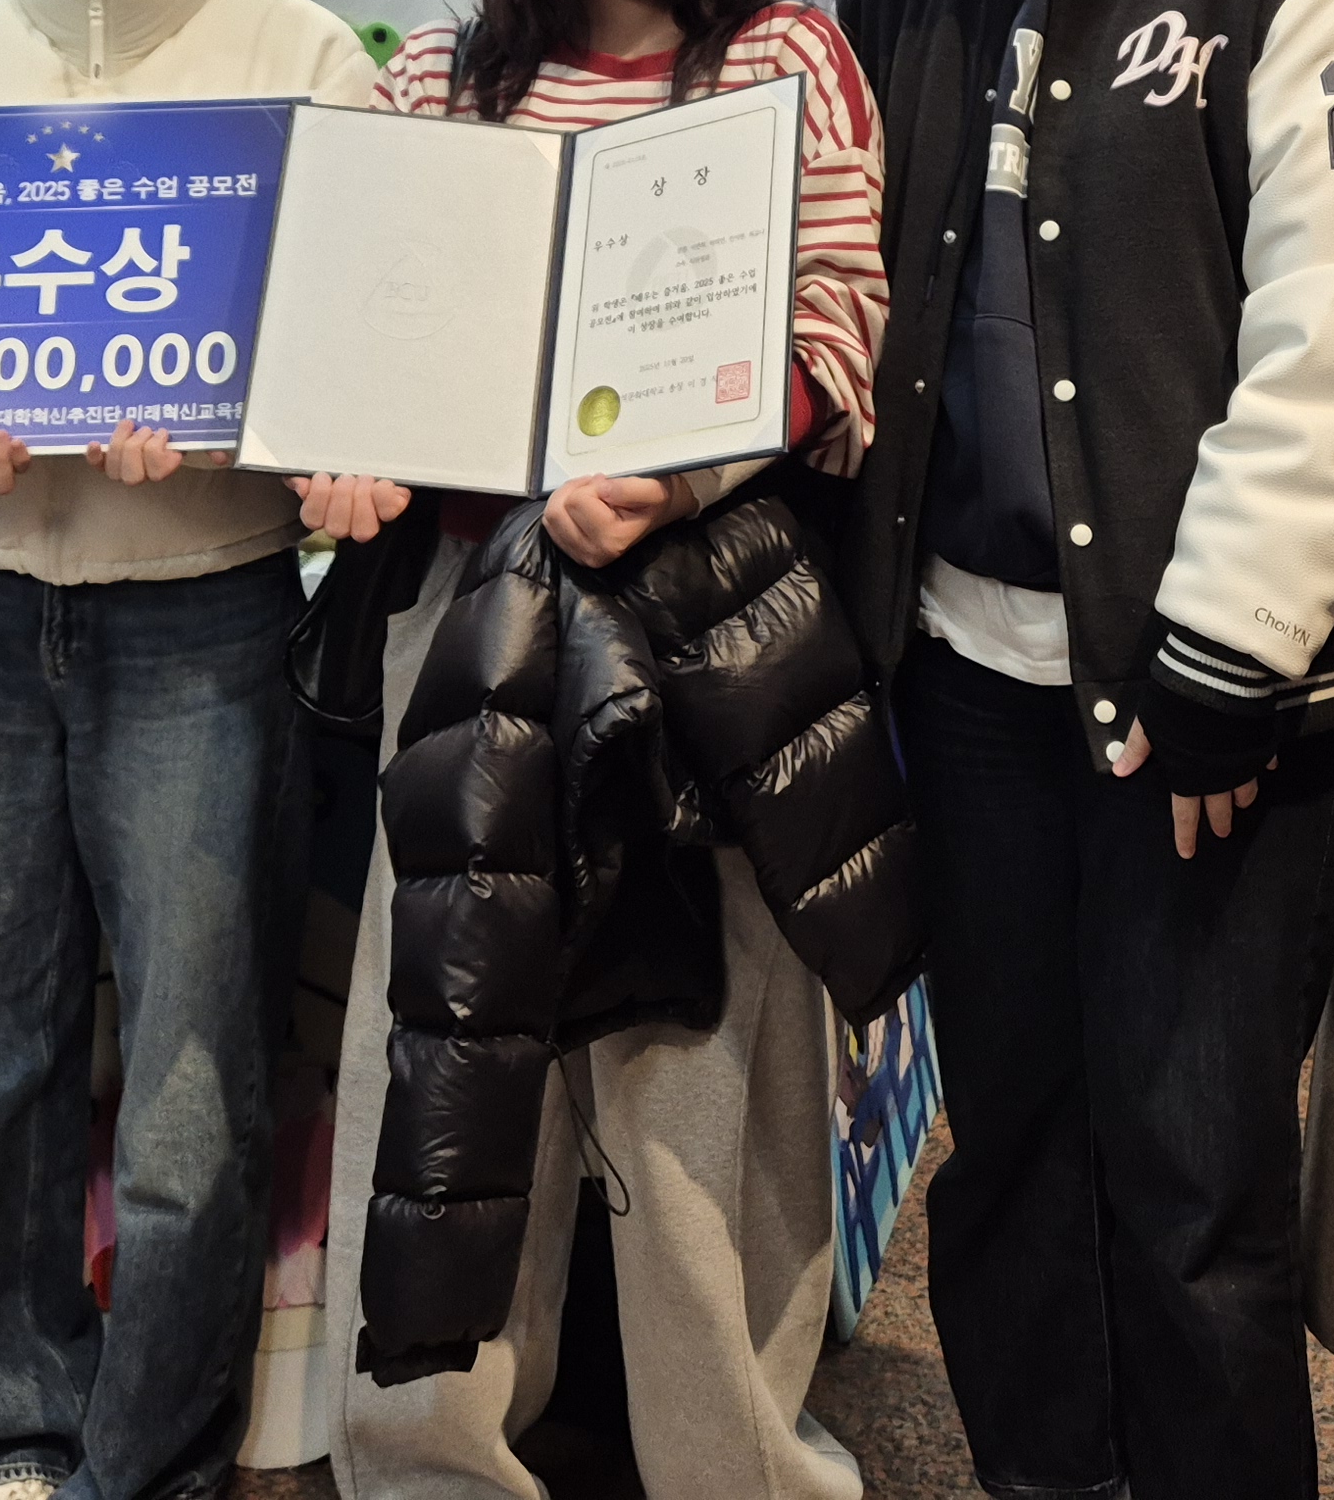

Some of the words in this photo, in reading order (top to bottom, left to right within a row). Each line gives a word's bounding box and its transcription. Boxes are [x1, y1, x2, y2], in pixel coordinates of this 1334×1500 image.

[18, 181, 70, 202] 2025
[77, 178, 125, 201] 좋은
[132, 176, 178, 199] 수업
[187, 173, 257, 198] 공모전
[651, 177, 666, 197] 상
[693, 166, 710, 186] 장
[593, 234, 629, 251] 우수상
[694, 278, 714, 290] 2025
